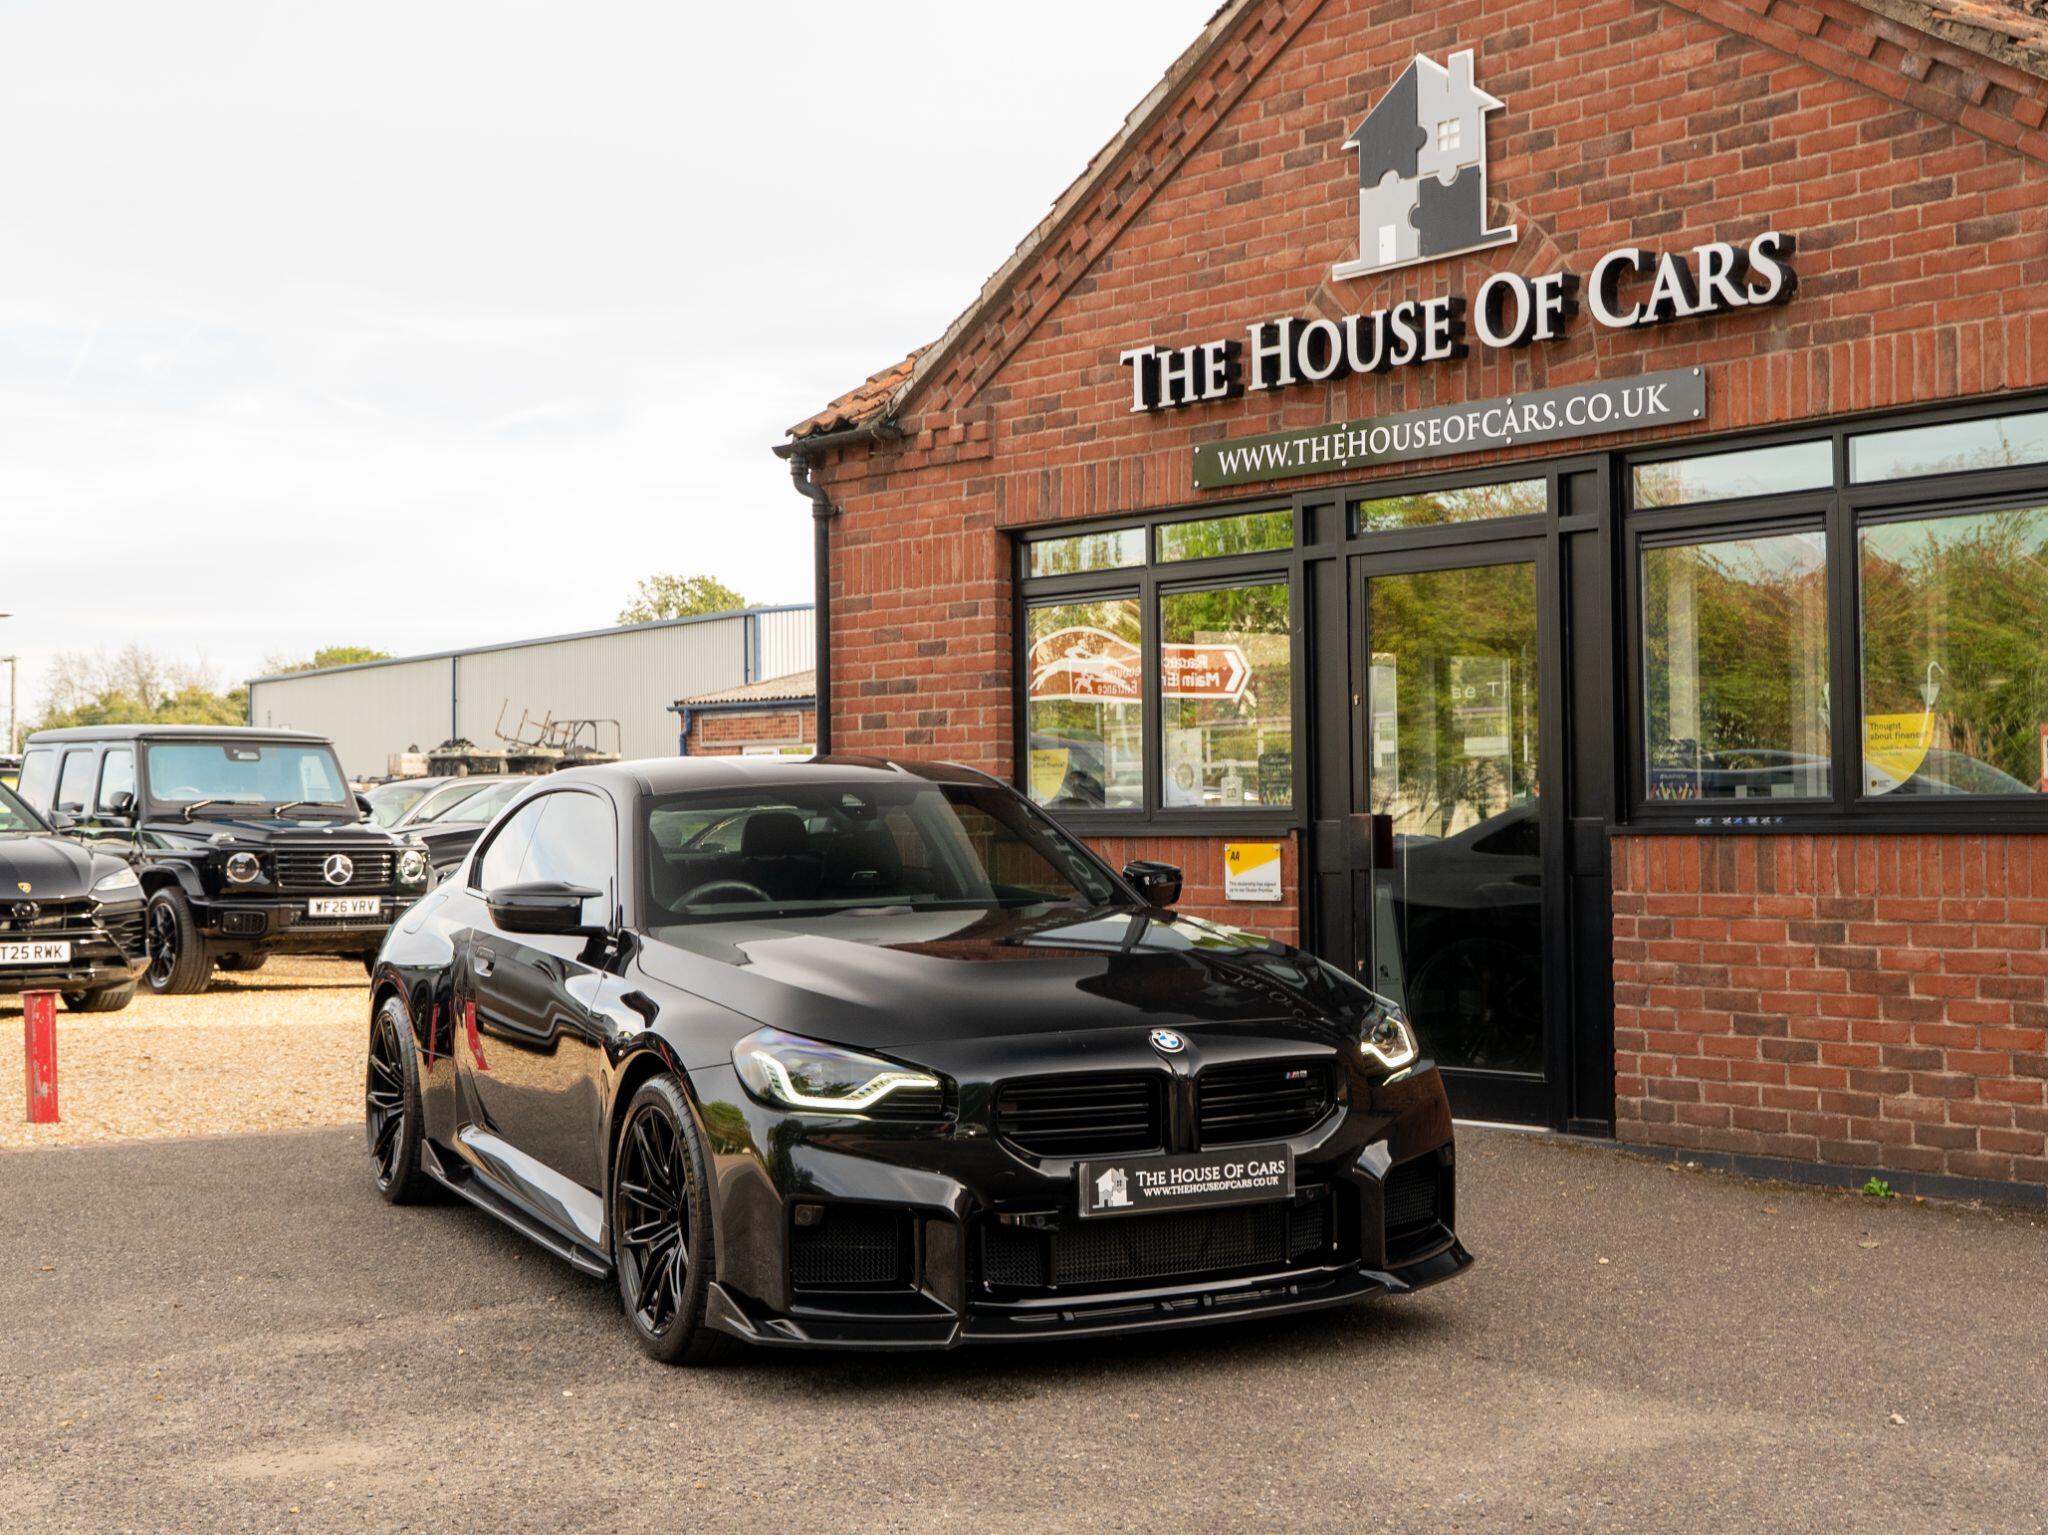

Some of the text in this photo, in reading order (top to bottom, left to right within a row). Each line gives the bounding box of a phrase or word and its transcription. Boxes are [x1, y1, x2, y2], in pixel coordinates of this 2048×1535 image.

[1120, 231, 1782, 413] THE HOUSE OF CARS
[1217, 383, 1671, 476] WWW.THEHOUSEOFCARS.CO.UK
[1870, 721, 1901, 732] Thought
[1870, 732, 1892, 741] about
[1230, 850, 1240, 861] AA
[315, 900, 375, 913] WF26 VRV
[0, 945, 63, 960] T25 RWK
[1135, 1160, 1286, 1187] THE HOUSE OF CARS
[1143, 1176, 1279, 1197] WWW.THEHOUSEOFCARSCOUK
